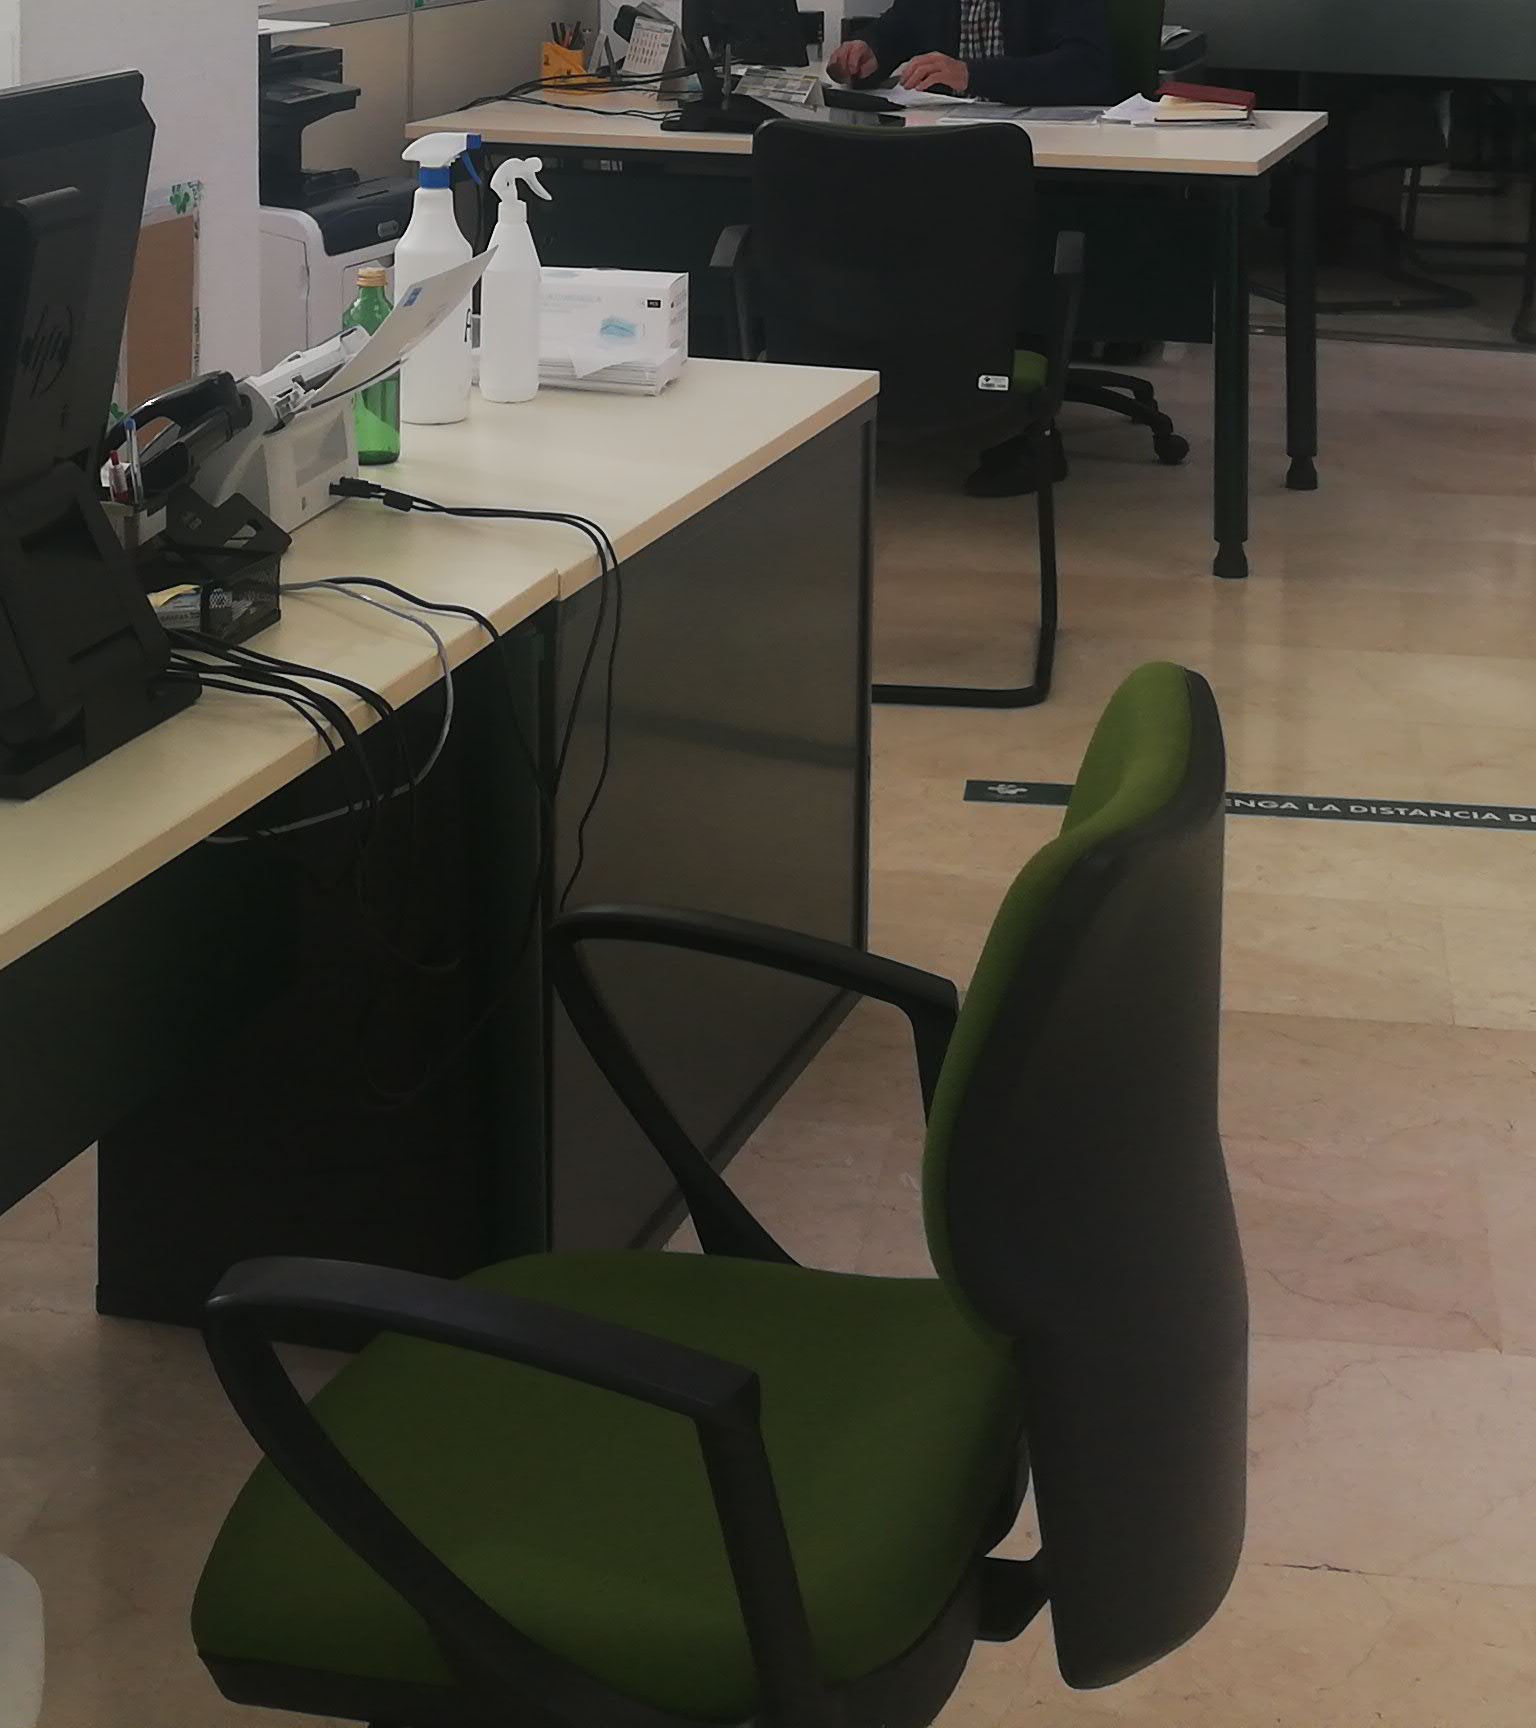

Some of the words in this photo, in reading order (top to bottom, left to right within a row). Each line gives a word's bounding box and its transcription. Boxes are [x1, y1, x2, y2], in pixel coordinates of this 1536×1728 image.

[1225, 798, 1299, 811] ENGA
[1307, 803, 1342, 813] LA
[1349, 805, 1502, 822] DISTANCIA
